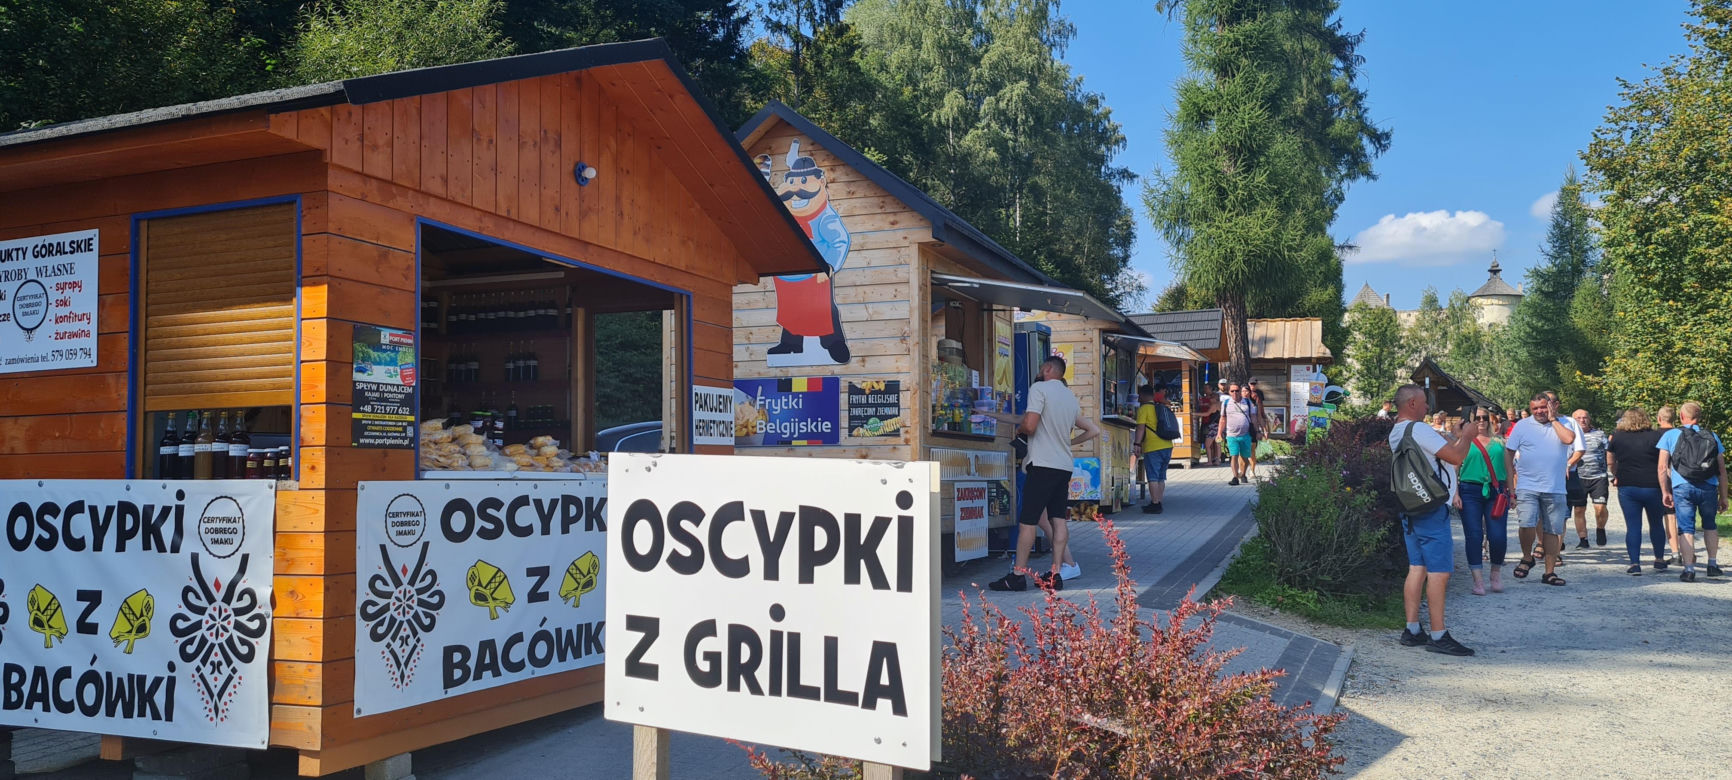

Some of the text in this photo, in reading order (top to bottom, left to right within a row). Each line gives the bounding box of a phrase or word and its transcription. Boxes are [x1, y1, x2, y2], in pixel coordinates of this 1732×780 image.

[32, 238, 94, 259] GÓRALSKIE
[35, 262, 76, 278] WŁASNE
[55, 280, 83, 294] syropy
[55, 296, 71, 308] soki
[54, 311, 92, 325] konfitury
[54, 328, 91, 341] żurawina
[5, 353, 40, 365] zamówienia
[40, 353, 50, 363] tel.
[51, 349, 65, 362] 579
[65, 348, 78, 361] 059
[79, 347, 92, 360] 794
[355, 382, 413, 393] SPŁYW DUNAJCEM
[694, 391, 733, 414] PAKUJEMY
[756, 394, 803, 415] Frytki
[850, 393, 899, 404] FRYTKI BELGIJSKIE
[373, 405, 385, 413] 721
[385, 406, 398, 414] 977
[398, 407, 410, 415] 632
[850, 406, 899, 417] ZAKRĘCONY ZIEMNIAK
[694, 418, 733, 438] HERMETYCZNIE
[756, 417, 832, 438] Belgijskie
[1407, 471, 1431, 503] adidas
[956, 487, 986, 503] ZAKRĘCONY
[203, 516, 242, 524] CERTYFIKAT
[388, 511, 423, 519] CERTYFIKAT
[960, 506, 984, 520] ZIEMNIAK
[204, 527, 238, 535] DOBREGO
[391, 520, 421, 528] DOBREGO
[210, 537, 234, 545] SMAKU
[526, 565, 550, 604] Z
[76, 590, 102, 635] Z
[625, 602, 908, 718] Z GRILLA
[2, 654, 177, 722] BACÓWKI
